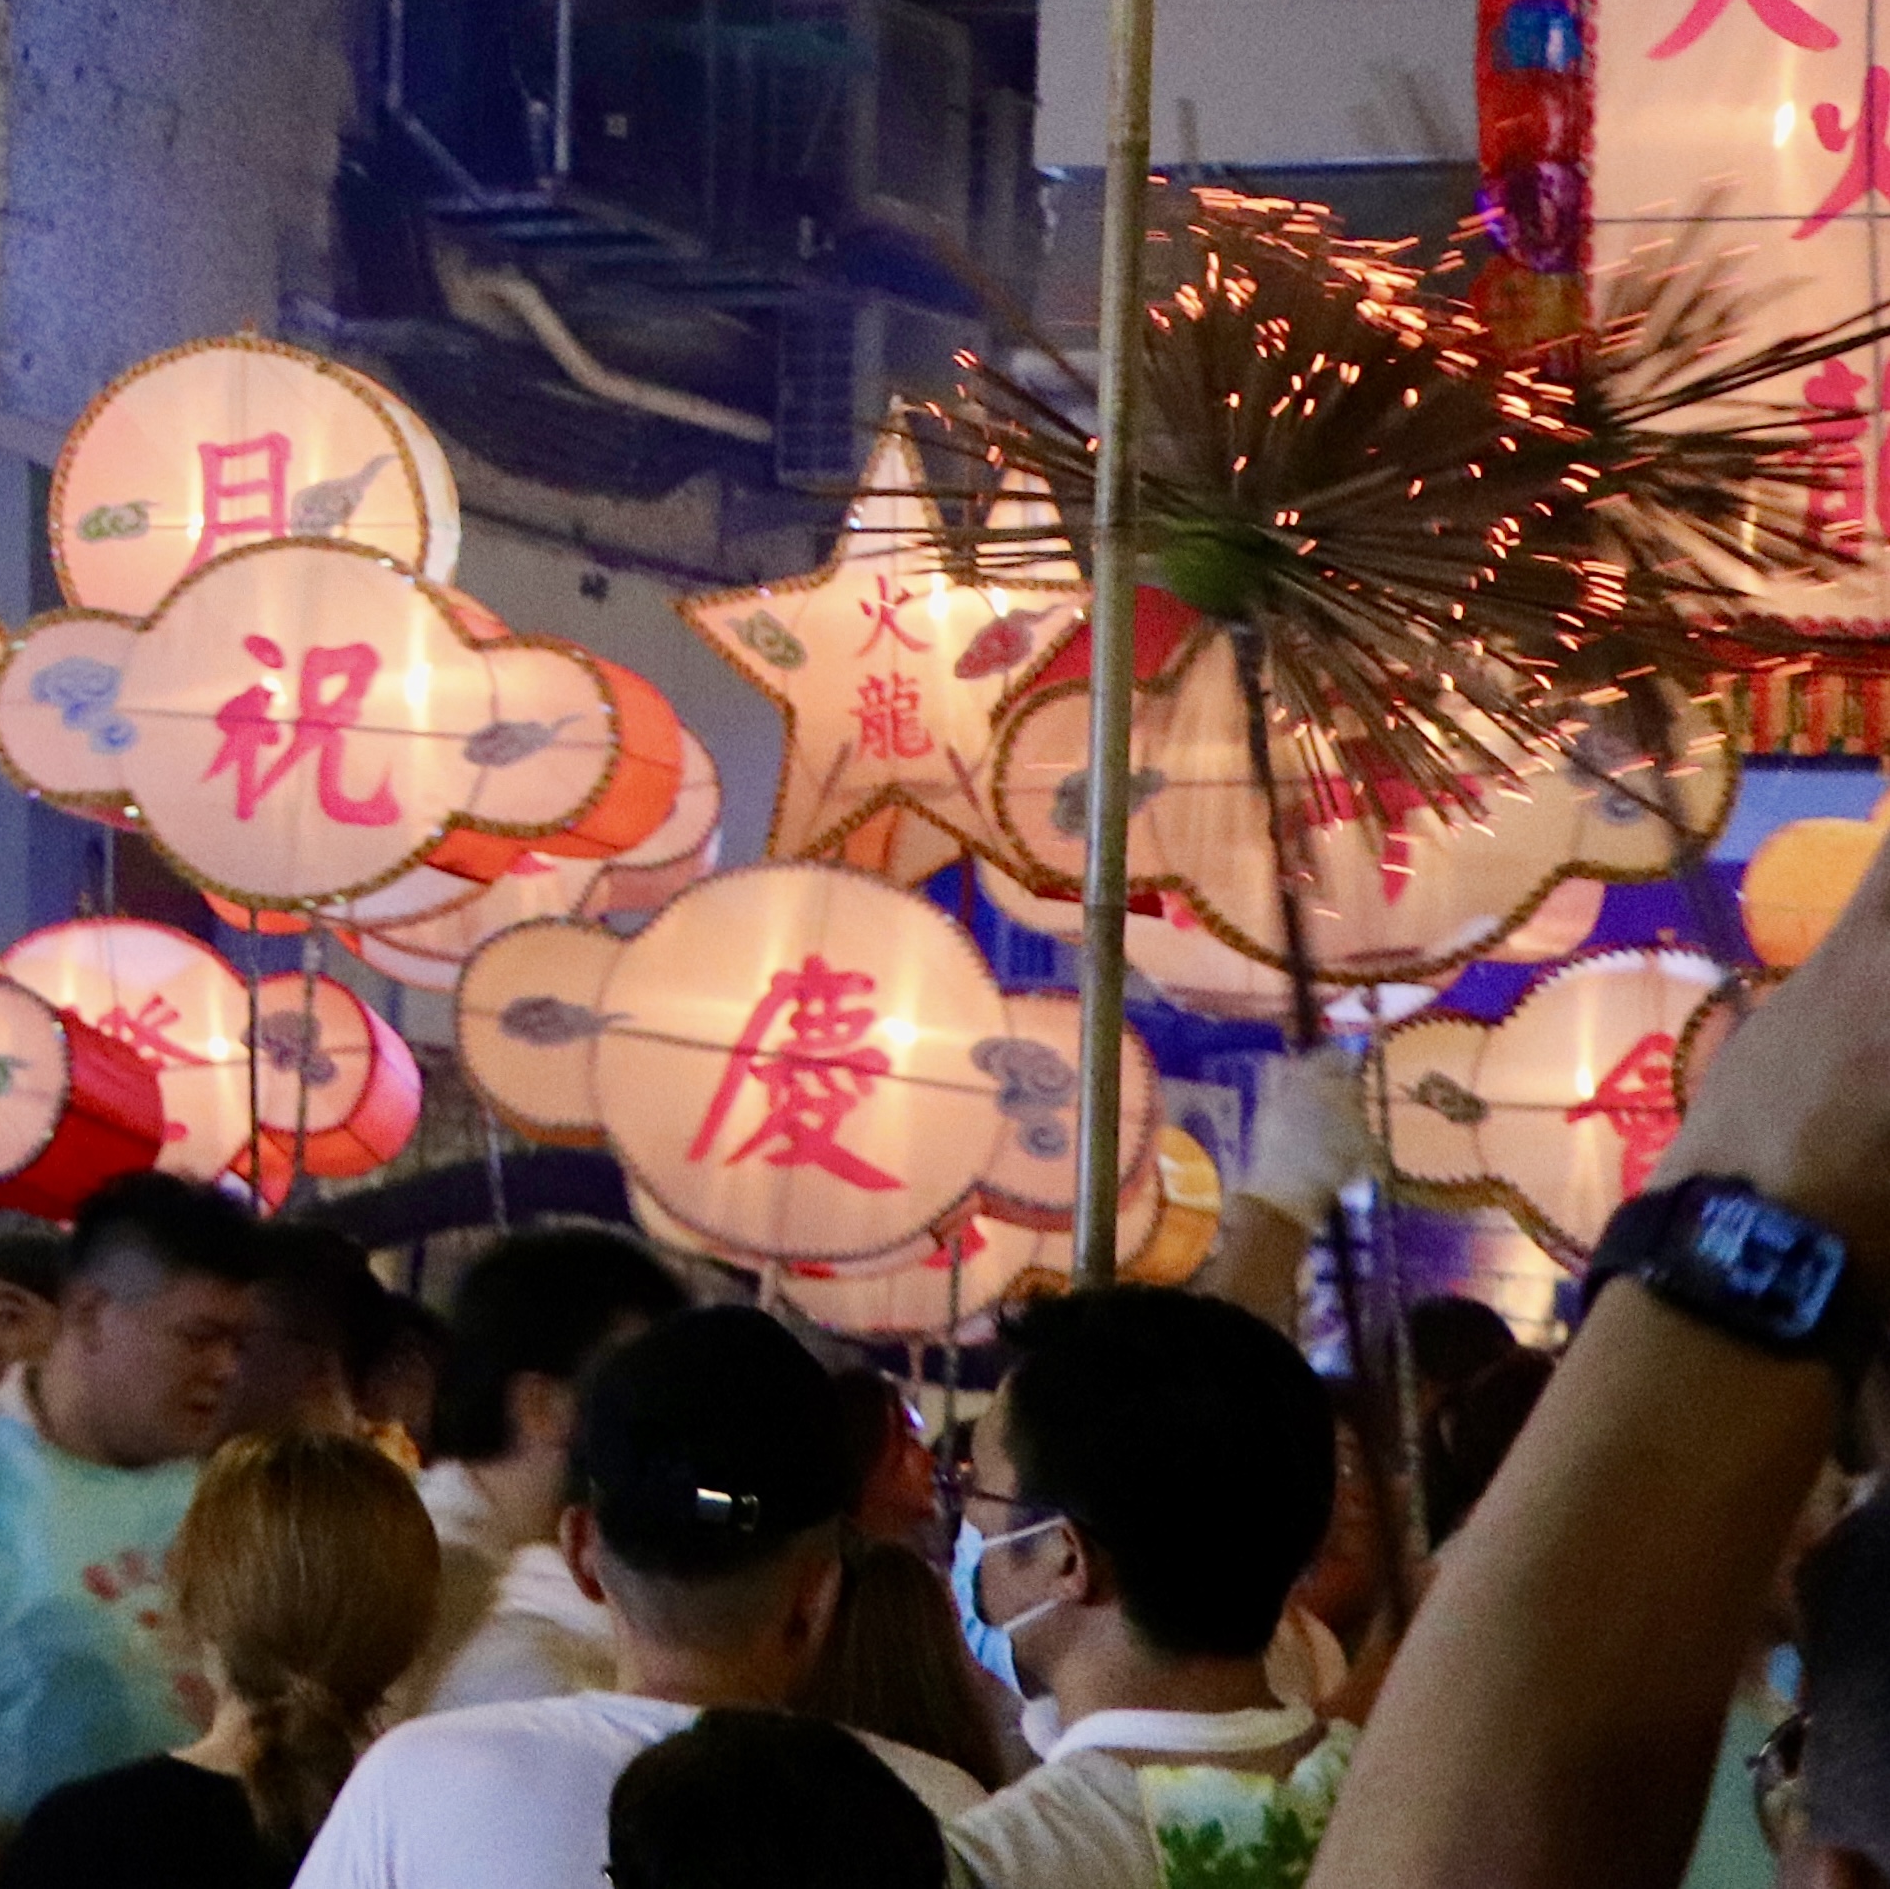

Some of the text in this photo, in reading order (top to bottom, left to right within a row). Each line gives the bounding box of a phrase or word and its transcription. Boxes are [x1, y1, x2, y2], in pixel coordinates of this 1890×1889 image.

[188, 430, 293, 572] 月
[202, 634, 400, 827] 祝
[851, 572, 935, 762] 火龍
[687, 953, 906, 1192] 慶
